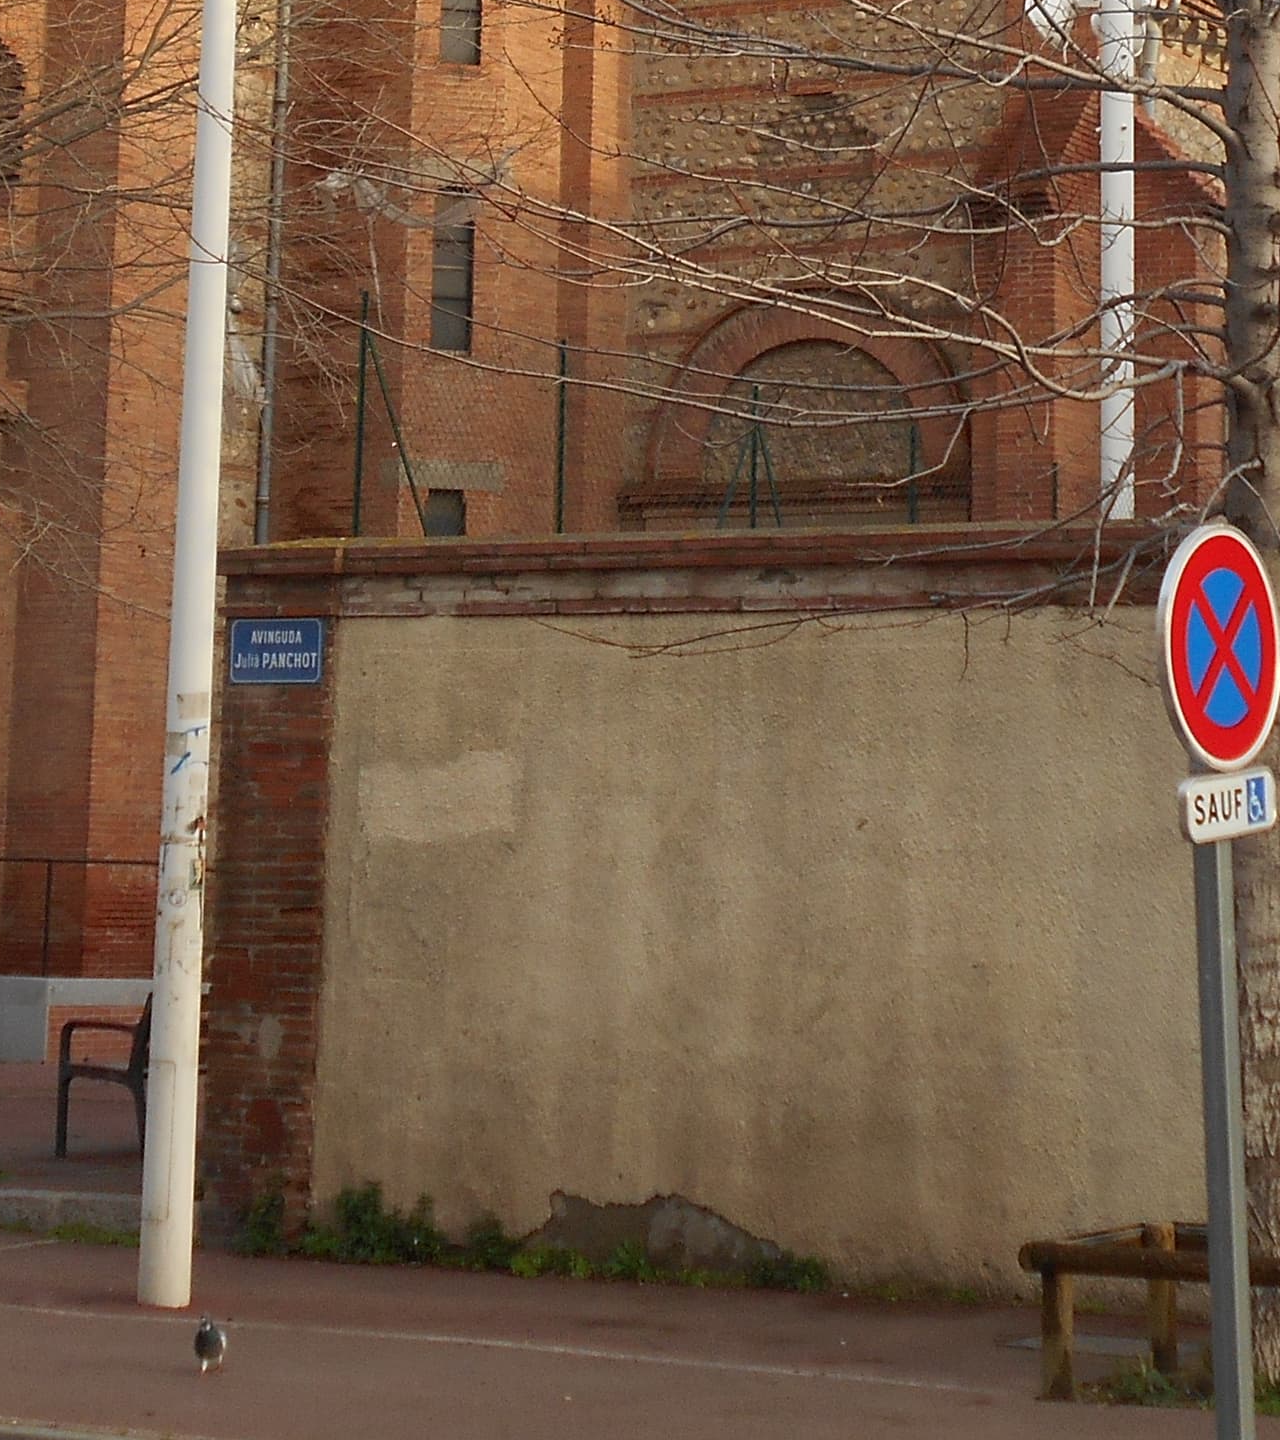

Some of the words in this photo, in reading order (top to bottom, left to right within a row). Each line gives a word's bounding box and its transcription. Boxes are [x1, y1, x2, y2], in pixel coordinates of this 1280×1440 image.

[251, 630, 302, 644] AVINGUDA
[262, 652, 317, 669] PANCHOT
[1194, 788, 1242, 825] SAUF
